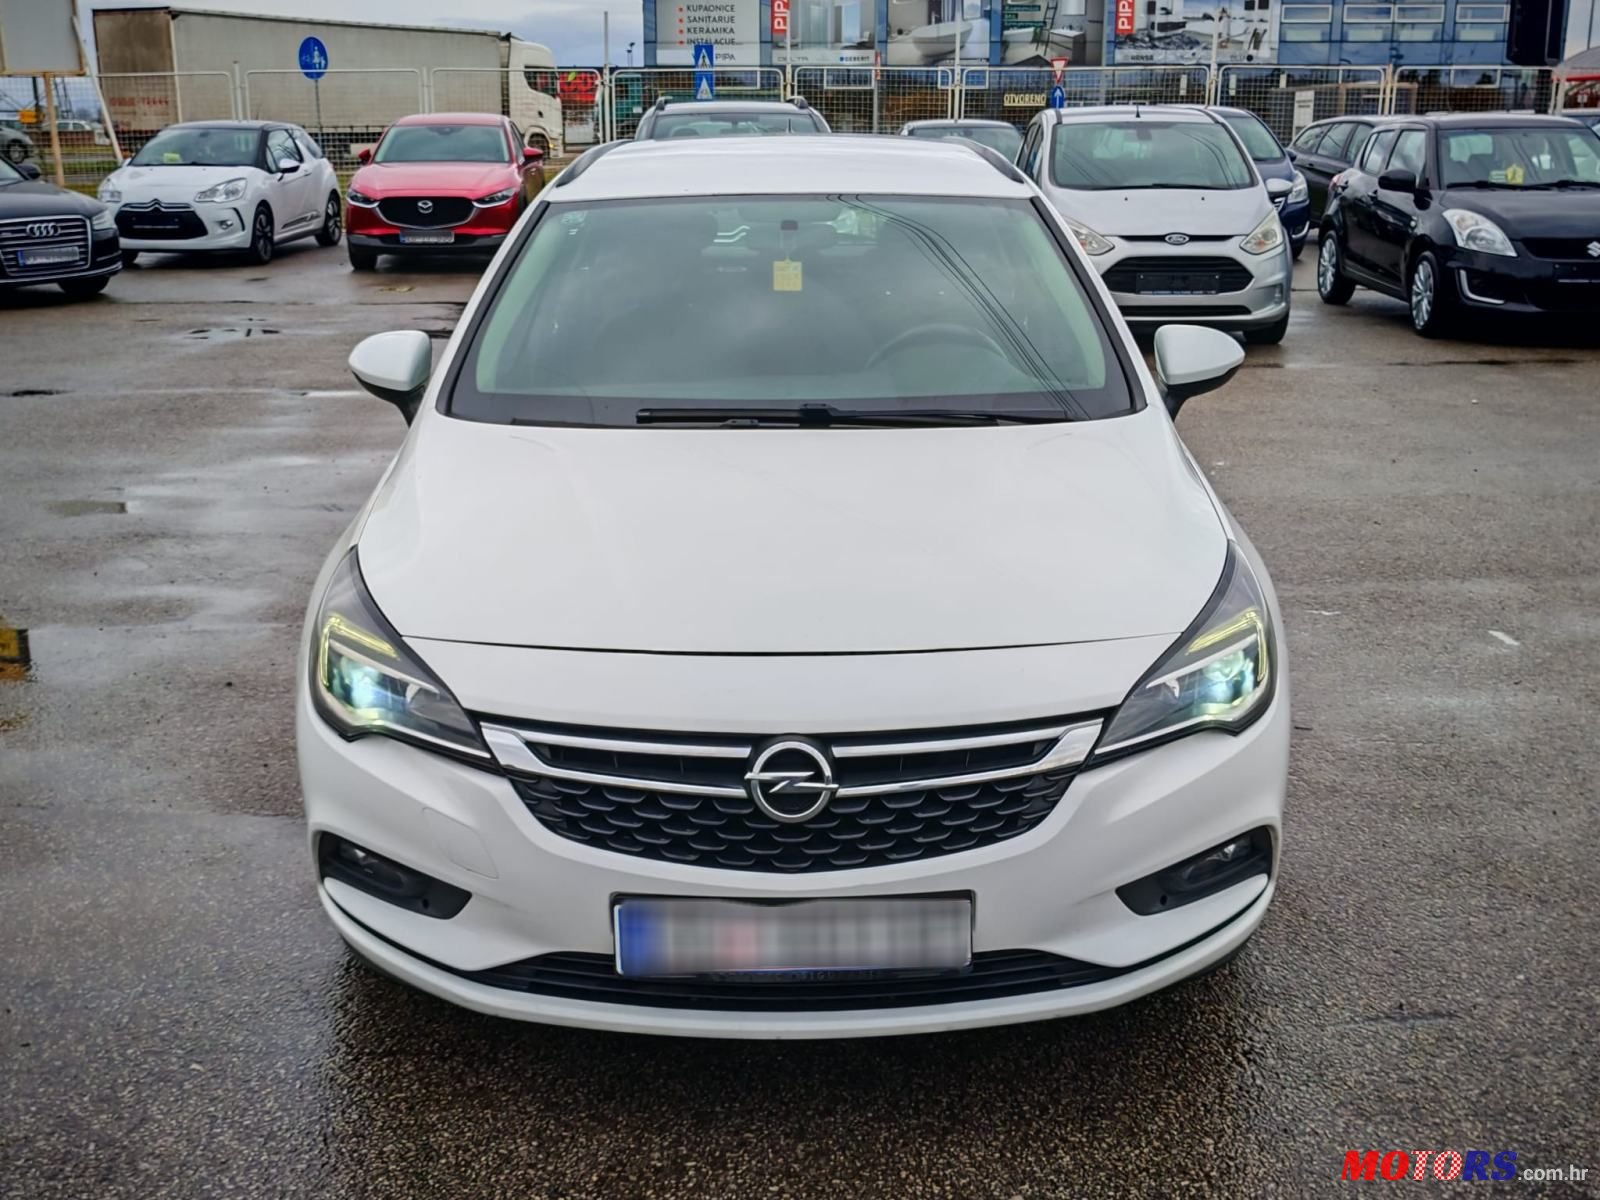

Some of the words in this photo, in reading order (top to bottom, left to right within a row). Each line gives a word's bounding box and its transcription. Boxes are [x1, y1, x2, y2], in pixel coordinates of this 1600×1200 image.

[687, 4, 736, 12] KUPAONICE
[687, 16, 735, 24] SANITARIJE
[687, 27, 735, 35] KERAMIKA
[1004, 94, 1046, 105] OTVORENO
